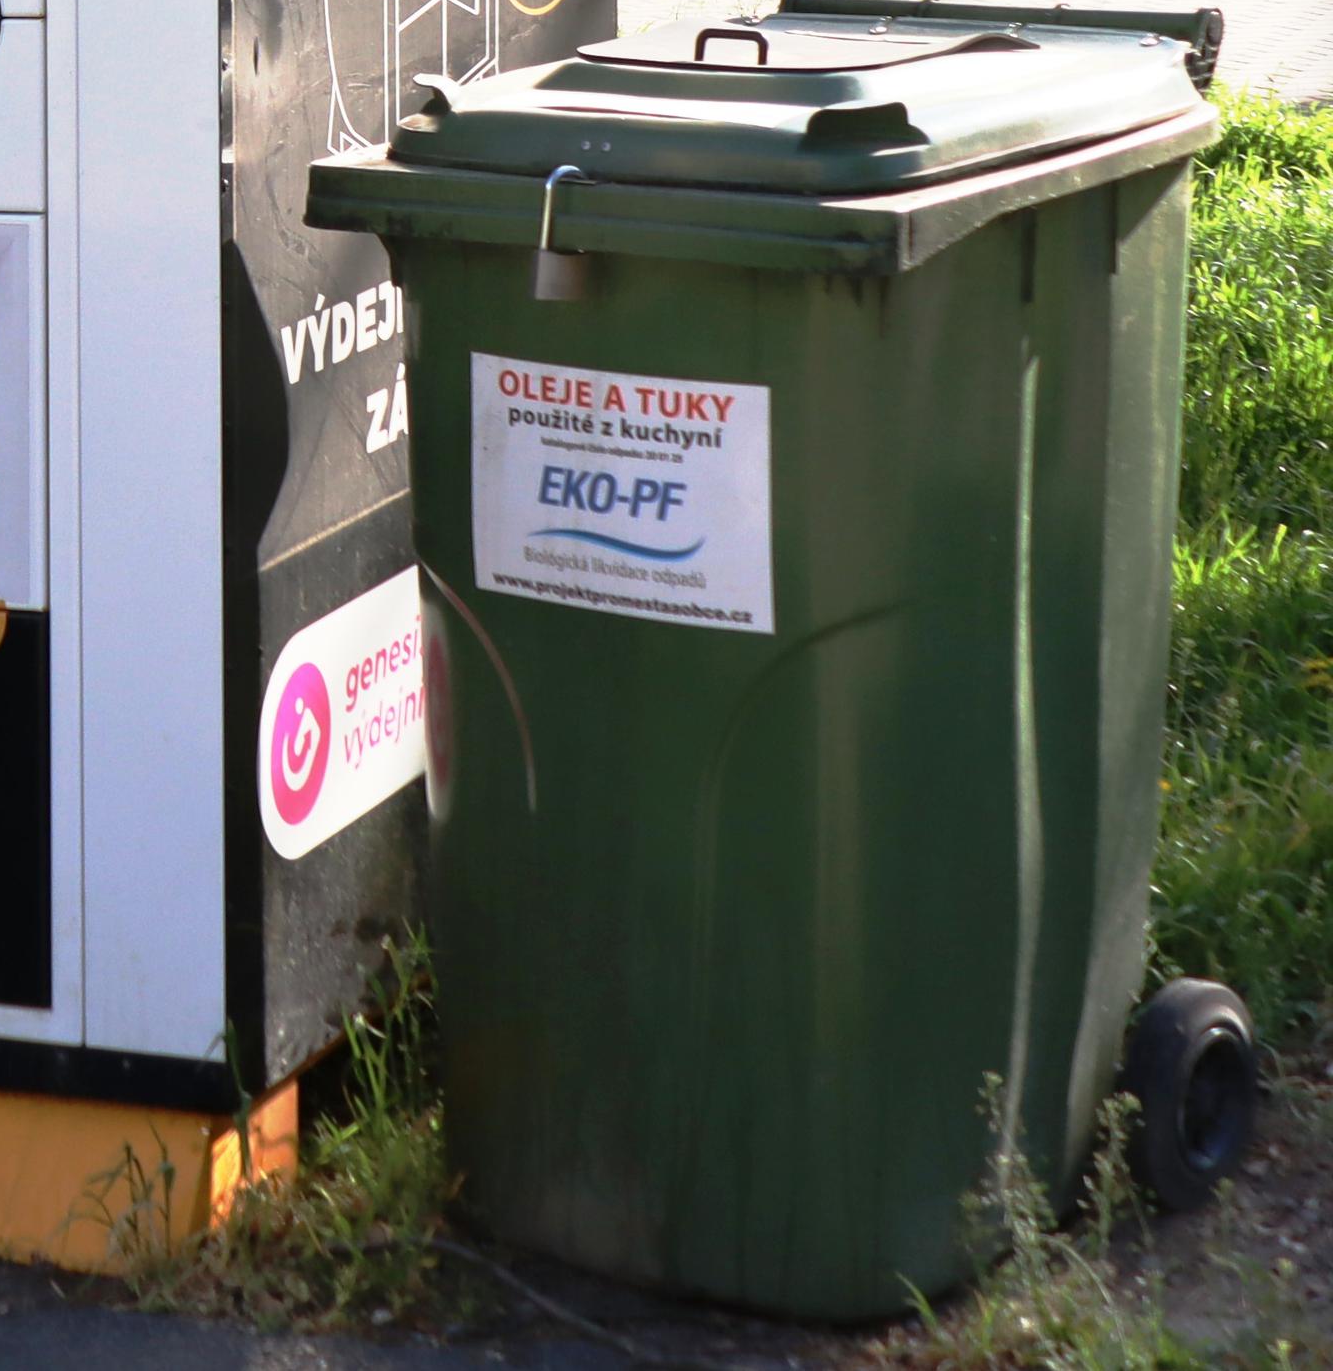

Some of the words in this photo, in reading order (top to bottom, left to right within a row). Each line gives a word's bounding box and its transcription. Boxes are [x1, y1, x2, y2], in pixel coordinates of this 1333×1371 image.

[497, 369, 593, 409] OLEJE
[602, 383, 626, 413] A
[634, 386, 735, 423] TUKY
[507, 404, 594, 434] použité
[600, 421, 614, 437] z
[619, 416, 722, 450] kuchyní
[537, 464, 687, 523] EKO-PF
[590, 555, 649, 582] likvidace
[345, 614, 424, 713] genesi
